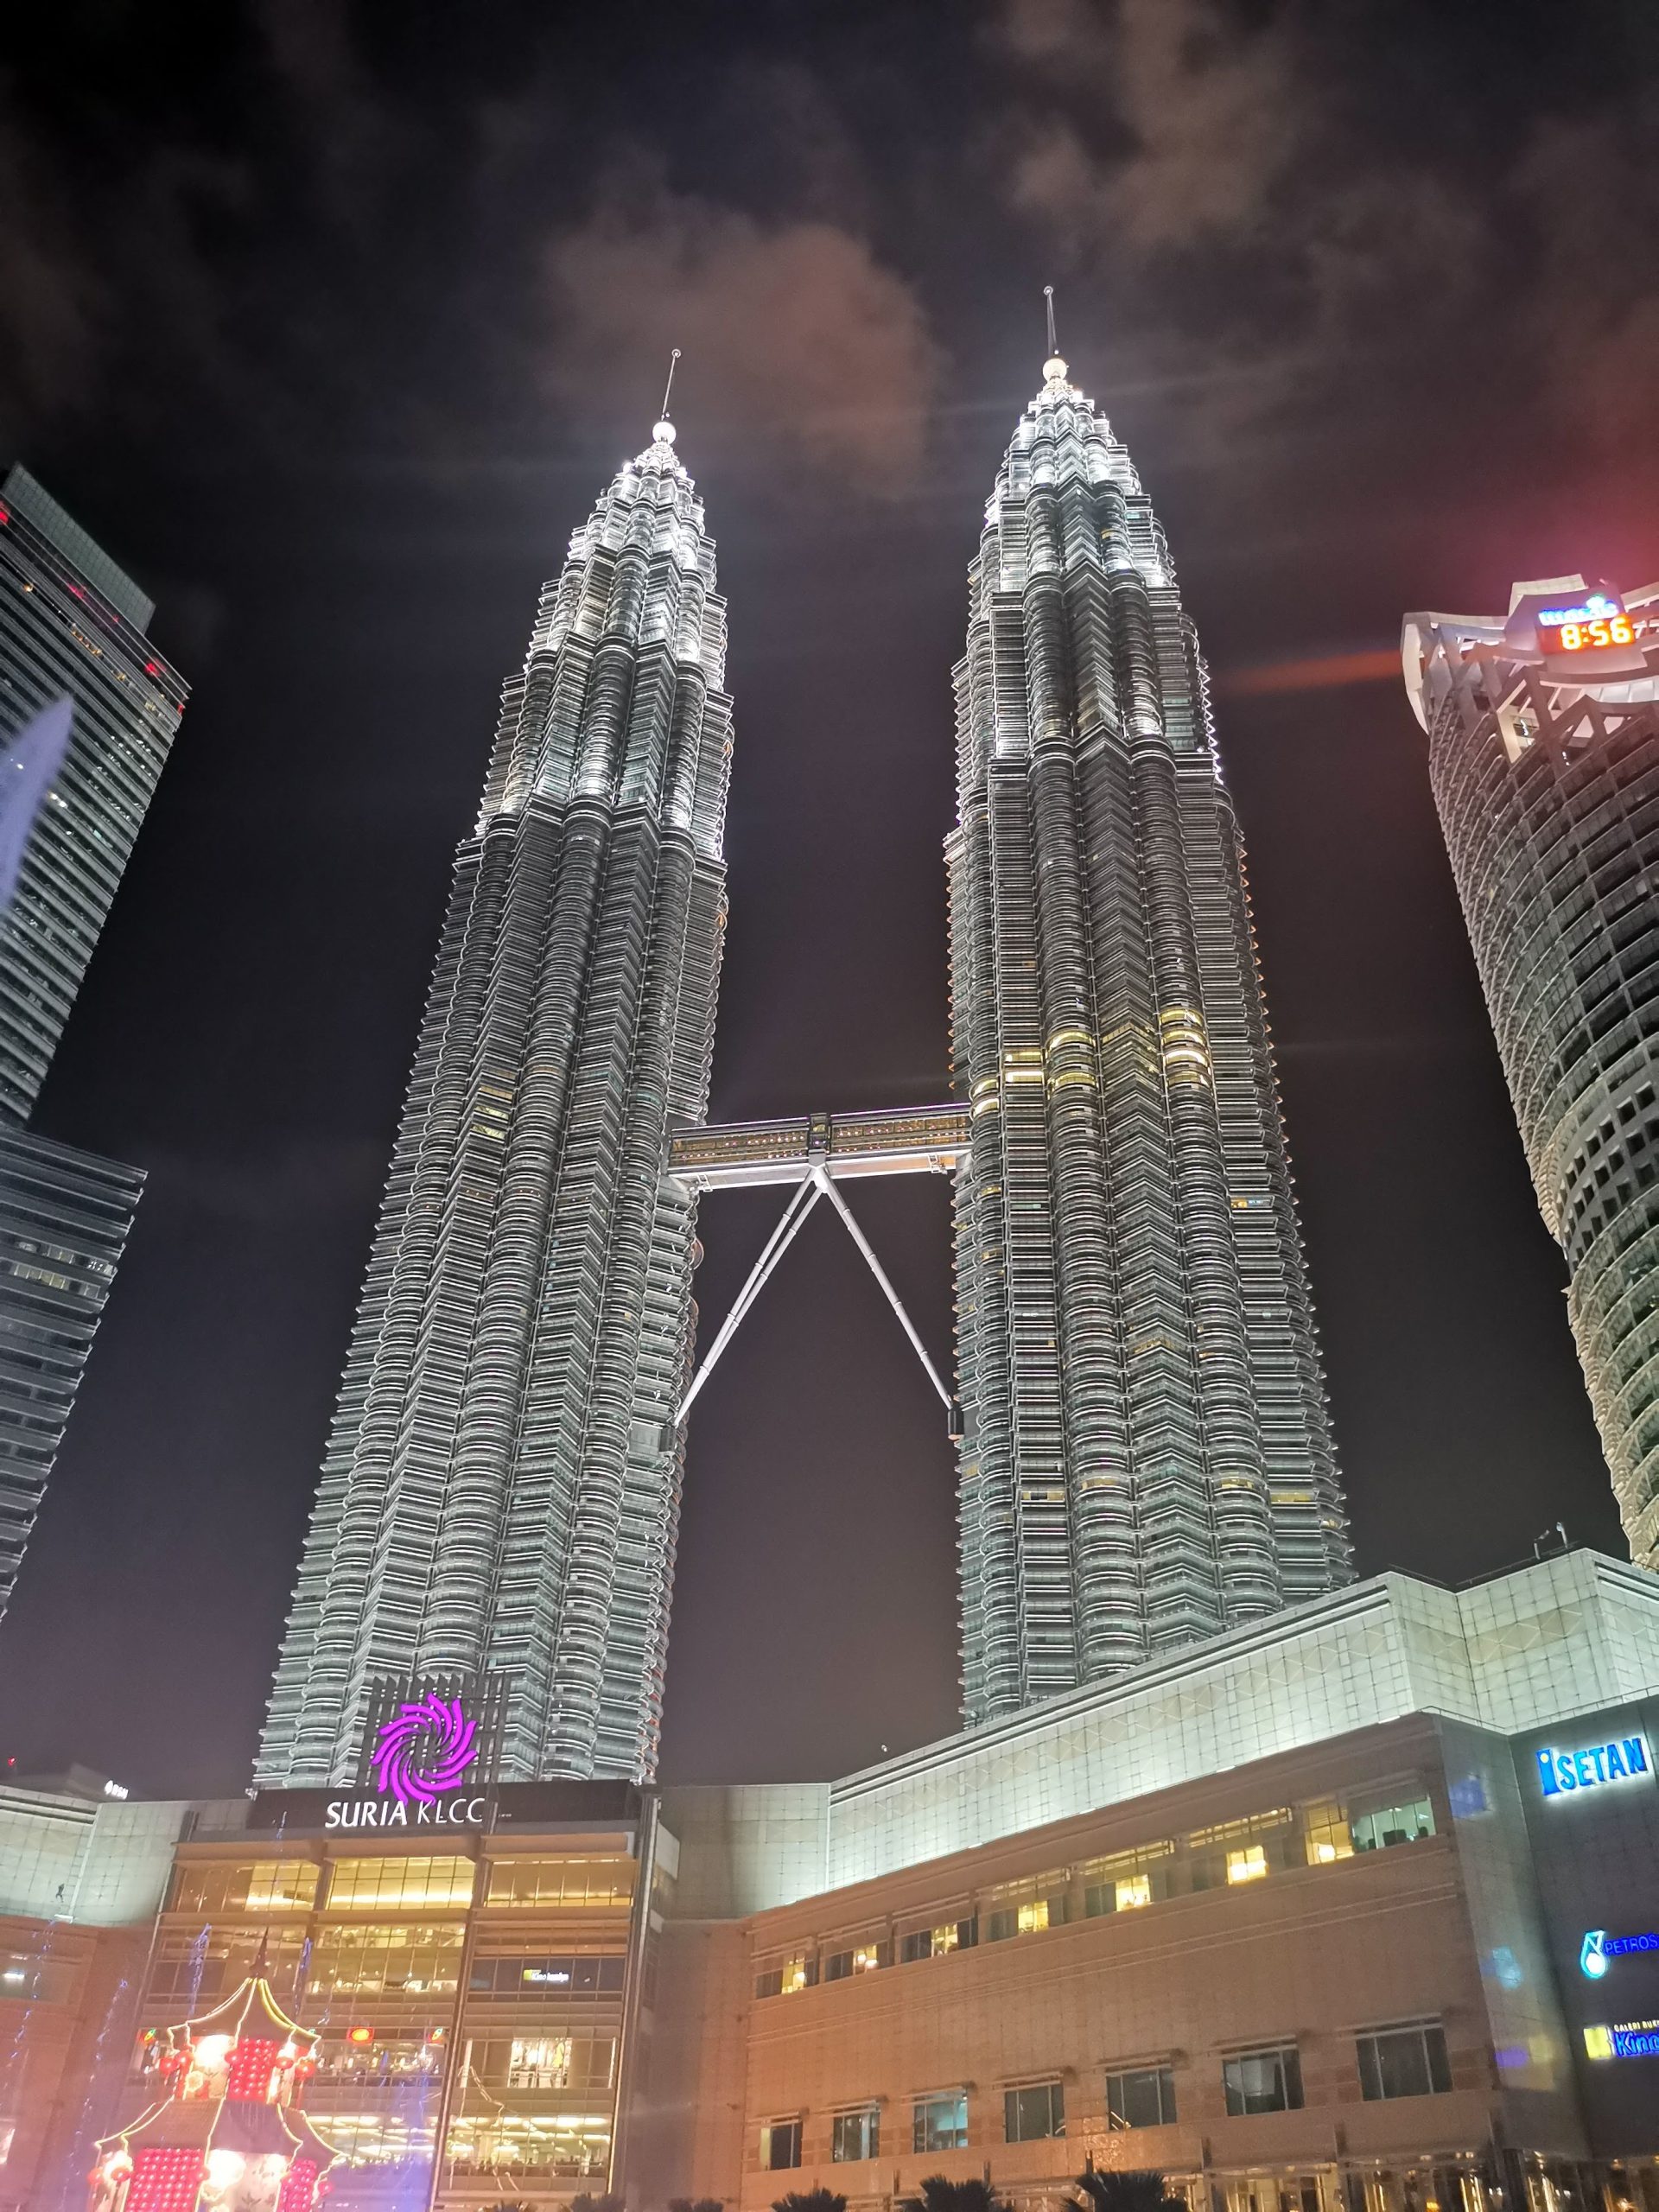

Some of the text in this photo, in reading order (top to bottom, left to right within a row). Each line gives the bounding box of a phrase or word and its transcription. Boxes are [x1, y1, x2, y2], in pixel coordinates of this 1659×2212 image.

[1560, 616, 1631, 650] 8:56
[325, 1798, 486, 1827] SURIA KLCC
